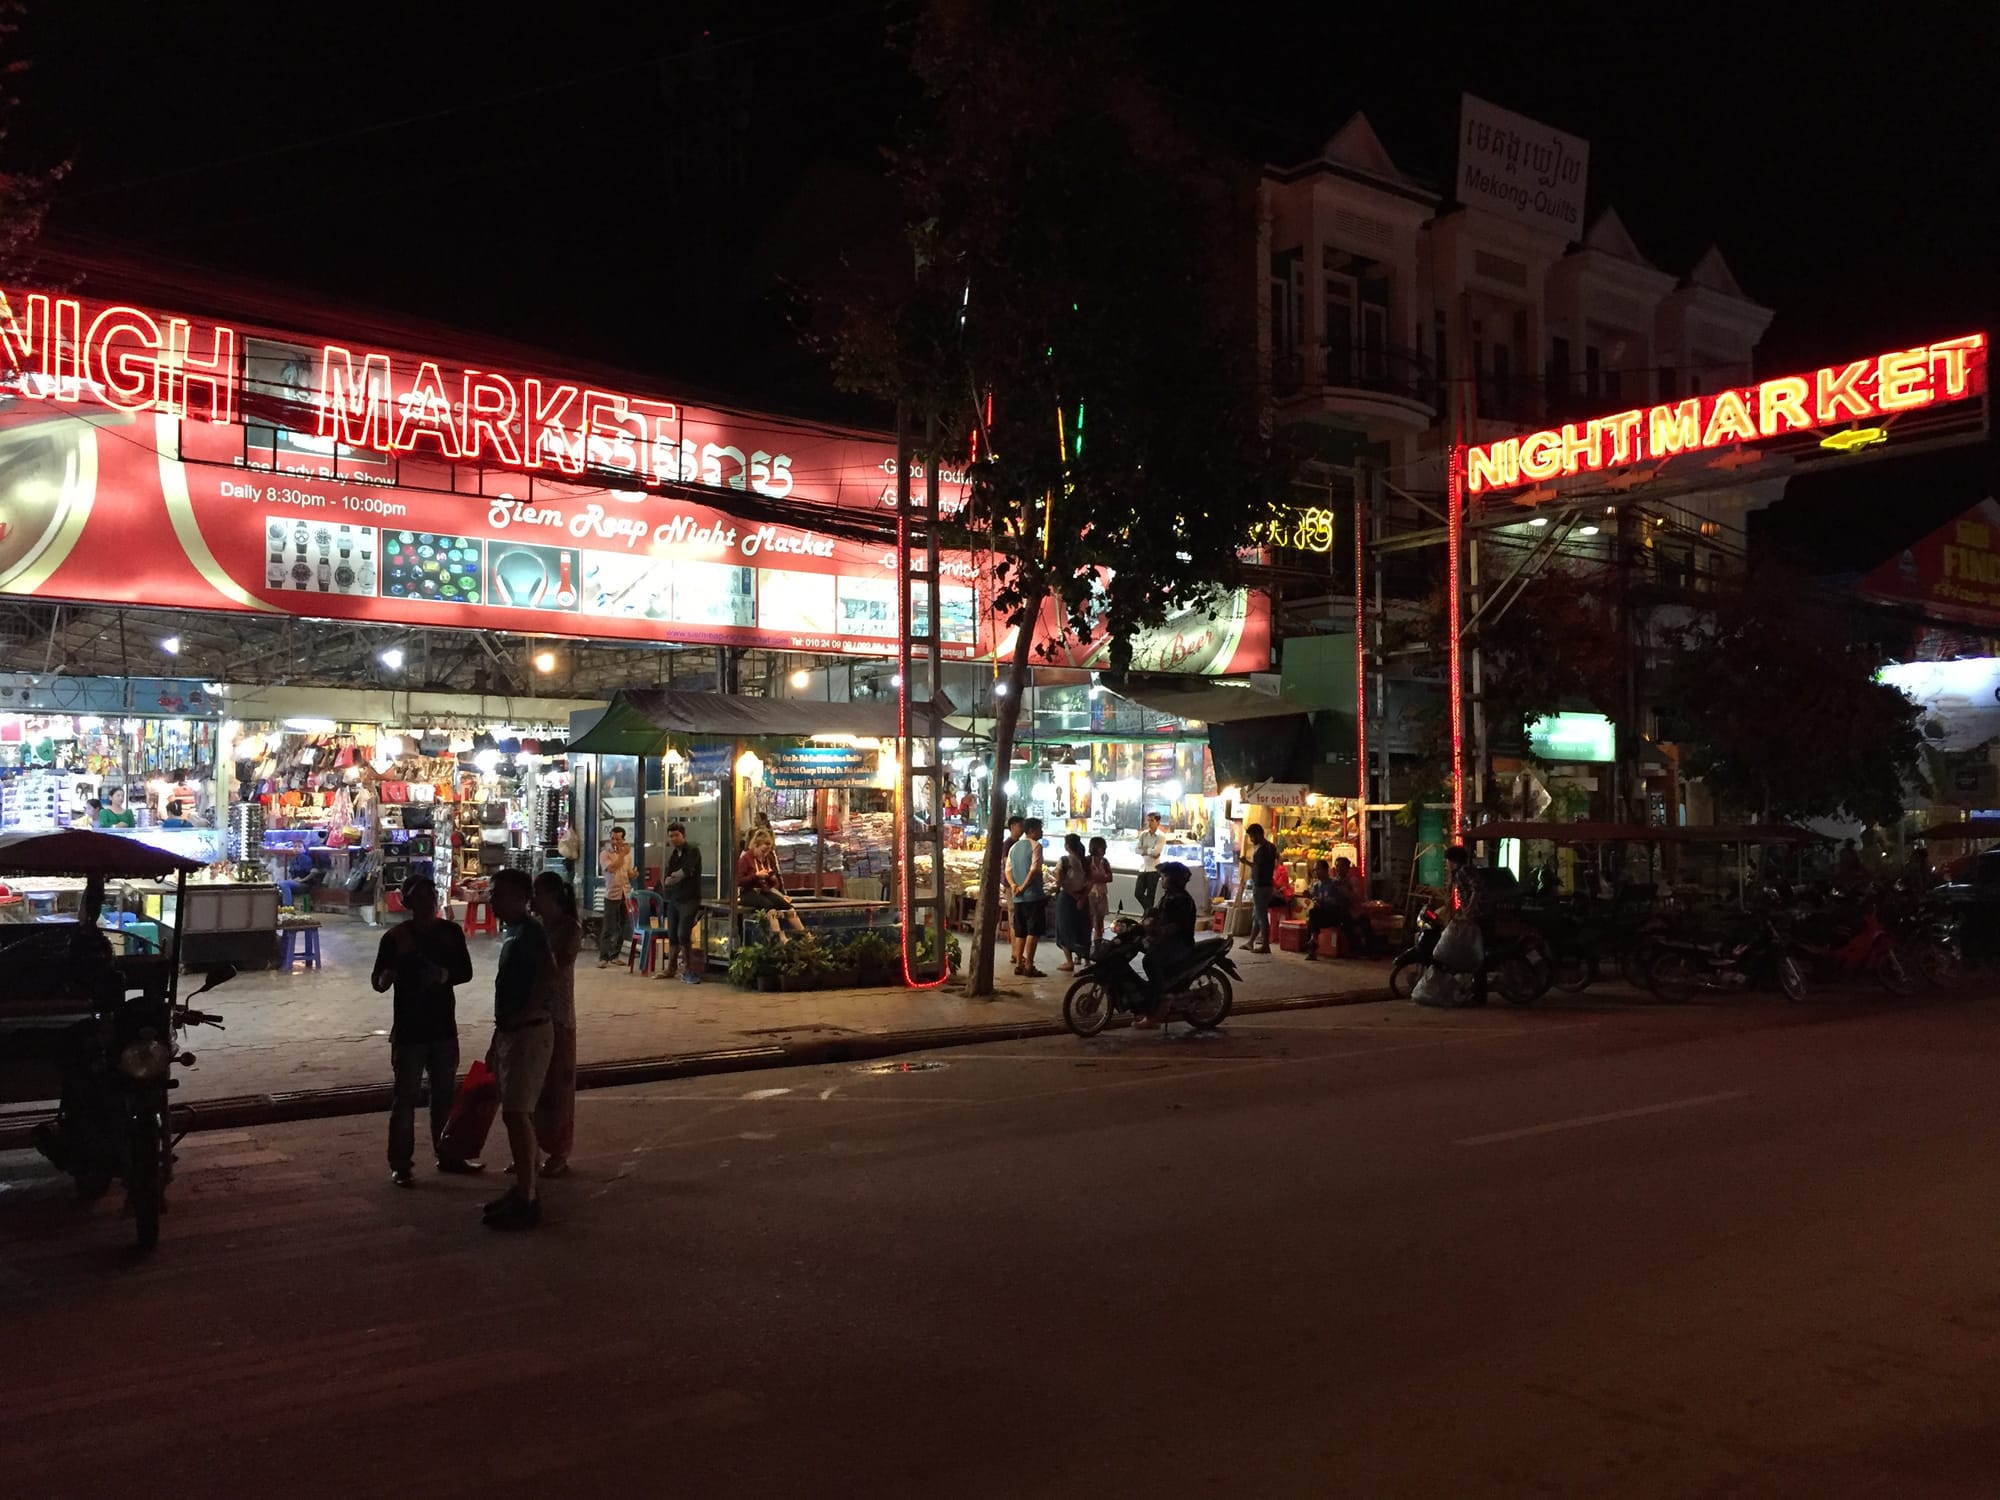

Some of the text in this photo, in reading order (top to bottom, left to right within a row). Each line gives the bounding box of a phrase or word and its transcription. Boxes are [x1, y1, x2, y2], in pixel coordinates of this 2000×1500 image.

[318, 344, 676, 486] MARKET
[1466, 332, 1986, 491] NIGHT MARKET
[276, 462, 315, 482] Lady
[353, 471, 396, 489] Show
[221, 481, 262, 502] Daily
[266, 488, 326, 509] 8:30pm
[341, 496, 407, 517] 10:00pm
[488, 493, 835, 557] Siem Reap Night Market
[1160, 631, 1214, 671] Beer
[800, 766, 817, 776] Charge
[1256, 793, 1269, 803] for
[1271, 794, 1290, 806] only
